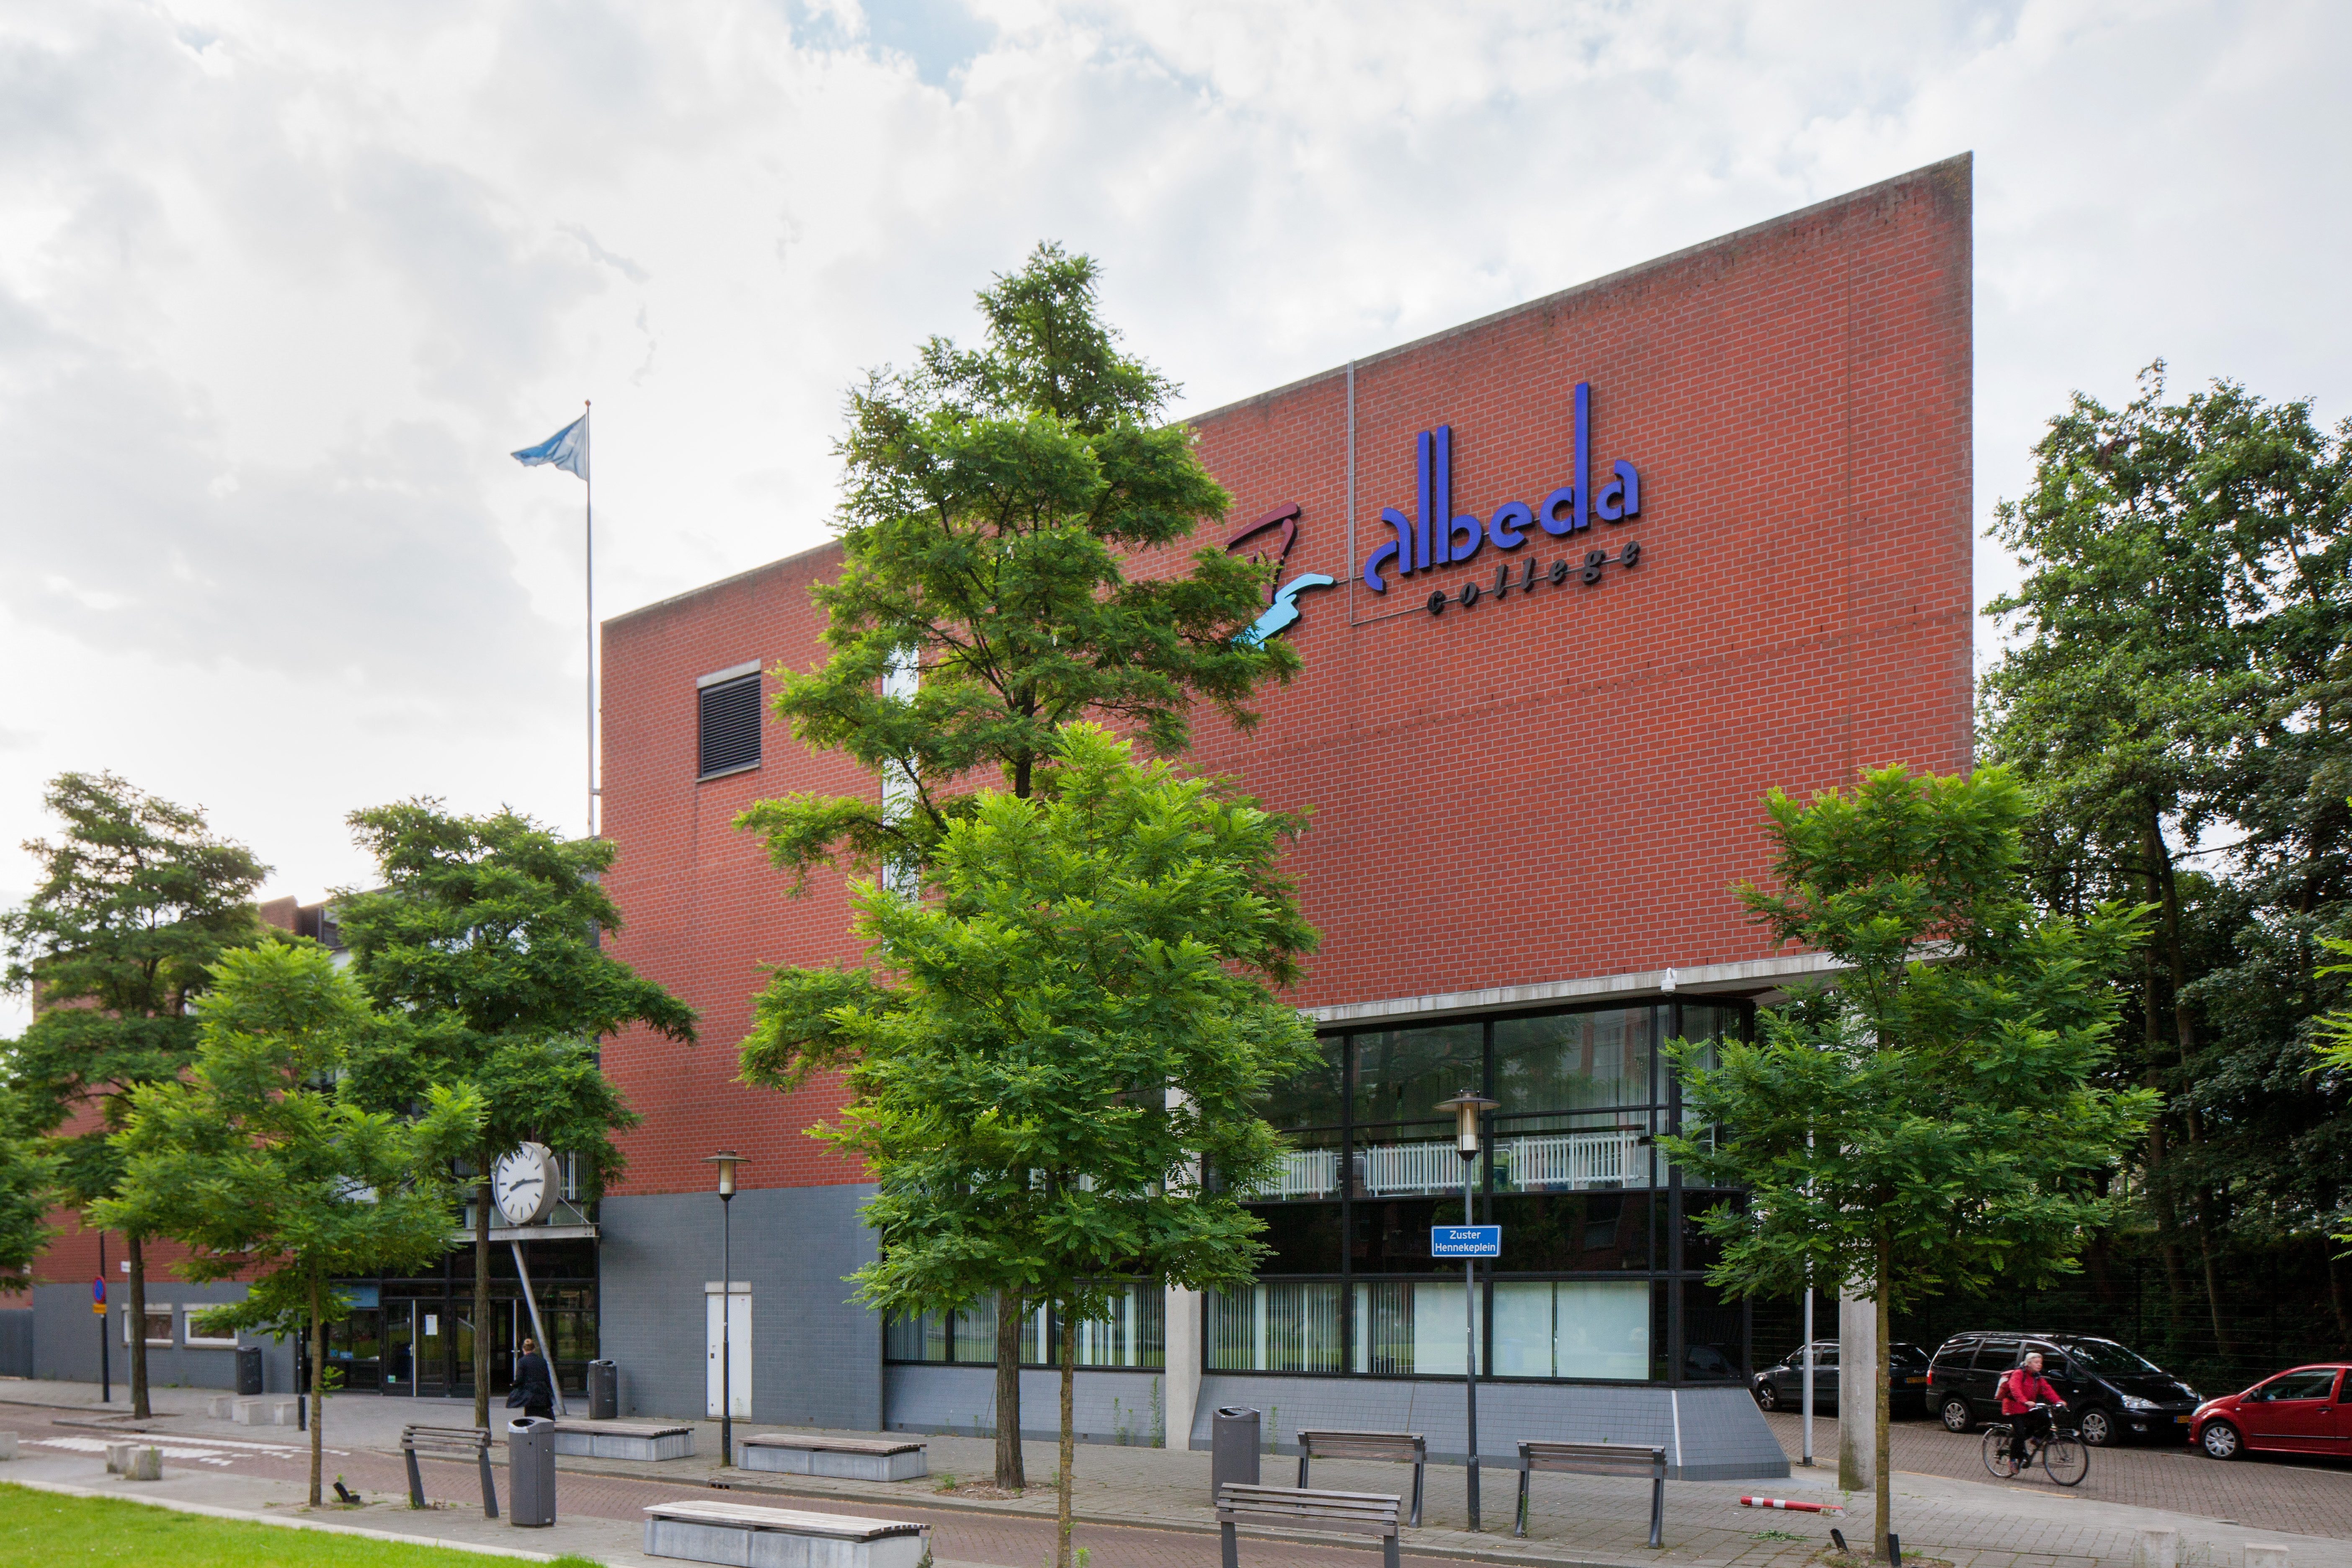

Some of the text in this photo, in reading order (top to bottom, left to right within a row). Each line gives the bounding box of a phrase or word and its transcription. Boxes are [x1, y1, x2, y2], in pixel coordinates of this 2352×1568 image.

[1364, 382, 1640, 591] albeda
[1427, 540, 1640, 614] college
[1435, 1243, 1496, 1253] Hennekeplein
[1449, 1230, 1481, 1239] Zuster
